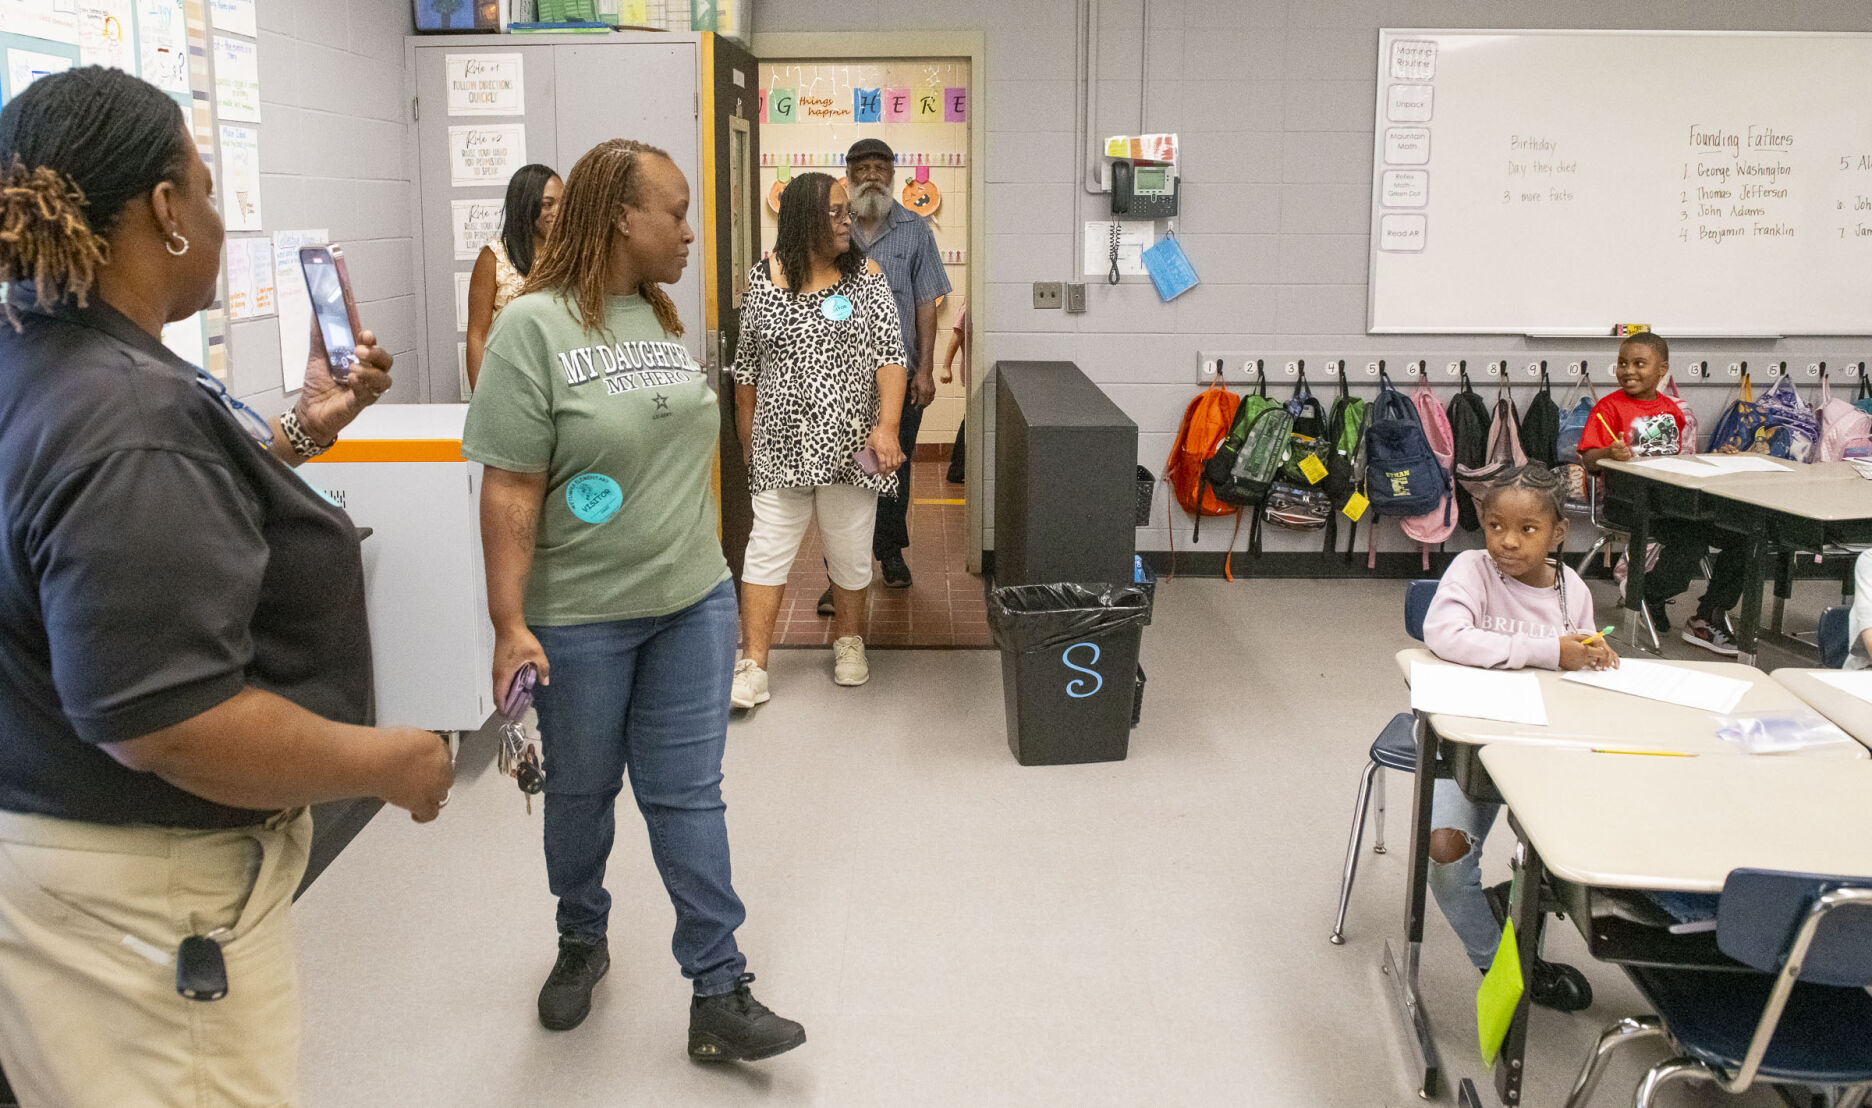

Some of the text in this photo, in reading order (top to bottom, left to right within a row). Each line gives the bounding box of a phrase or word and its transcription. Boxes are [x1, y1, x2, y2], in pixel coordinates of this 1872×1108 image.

[1396, 47, 1432, 58] Morning
[1397, 58, 1430, 68] Routine
[799, 96, 834, 109] things
[1395, 100, 1425, 109] Unpack
[1689, 124, 1794, 158] Founding Fathers
[1511, 135, 1558, 159] Birthday
[1840, 154, 1872, 171] 5 Al
[1508, 159, 1577, 178] Day they died
[1697, 162, 1730, 184] George
[1736, 160, 1791, 184] Washington
[1521, 192, 1541, 202] more
[1550, 186, 1575, 201] facts
[1681, 184, 1788, 203] 2 Thomas Jefferson
[1681, 204, 1765, 221] 3 John Adams
[1699, 225, 1745, 244] Benjamin
[1753, 222, 1795, 237] Franklin
[558, 347, 600, 388] MY
[1247, 362, 1253, 372] 2
[1288, 363, 1295, 373] 3
[1328, 363, 1335, 373] 4
[1369, 364, 1376, 373] 5
[1410, 365, 1416, 374] 6
[1450, 364, 1457, 373] 7
[1490, 365, 1497, 374] 8
[1530, 365, 1537, 374] 9
[1570, 365, 1579, 374] 10
[1691, 365, 1699, 374] 13
[1769, 365, 1778, 375] 15
[1848, 366, 1856, 375] 17
[604, 371, 691, 395] MY HERO
[1062, 642, 1103, 698] S
